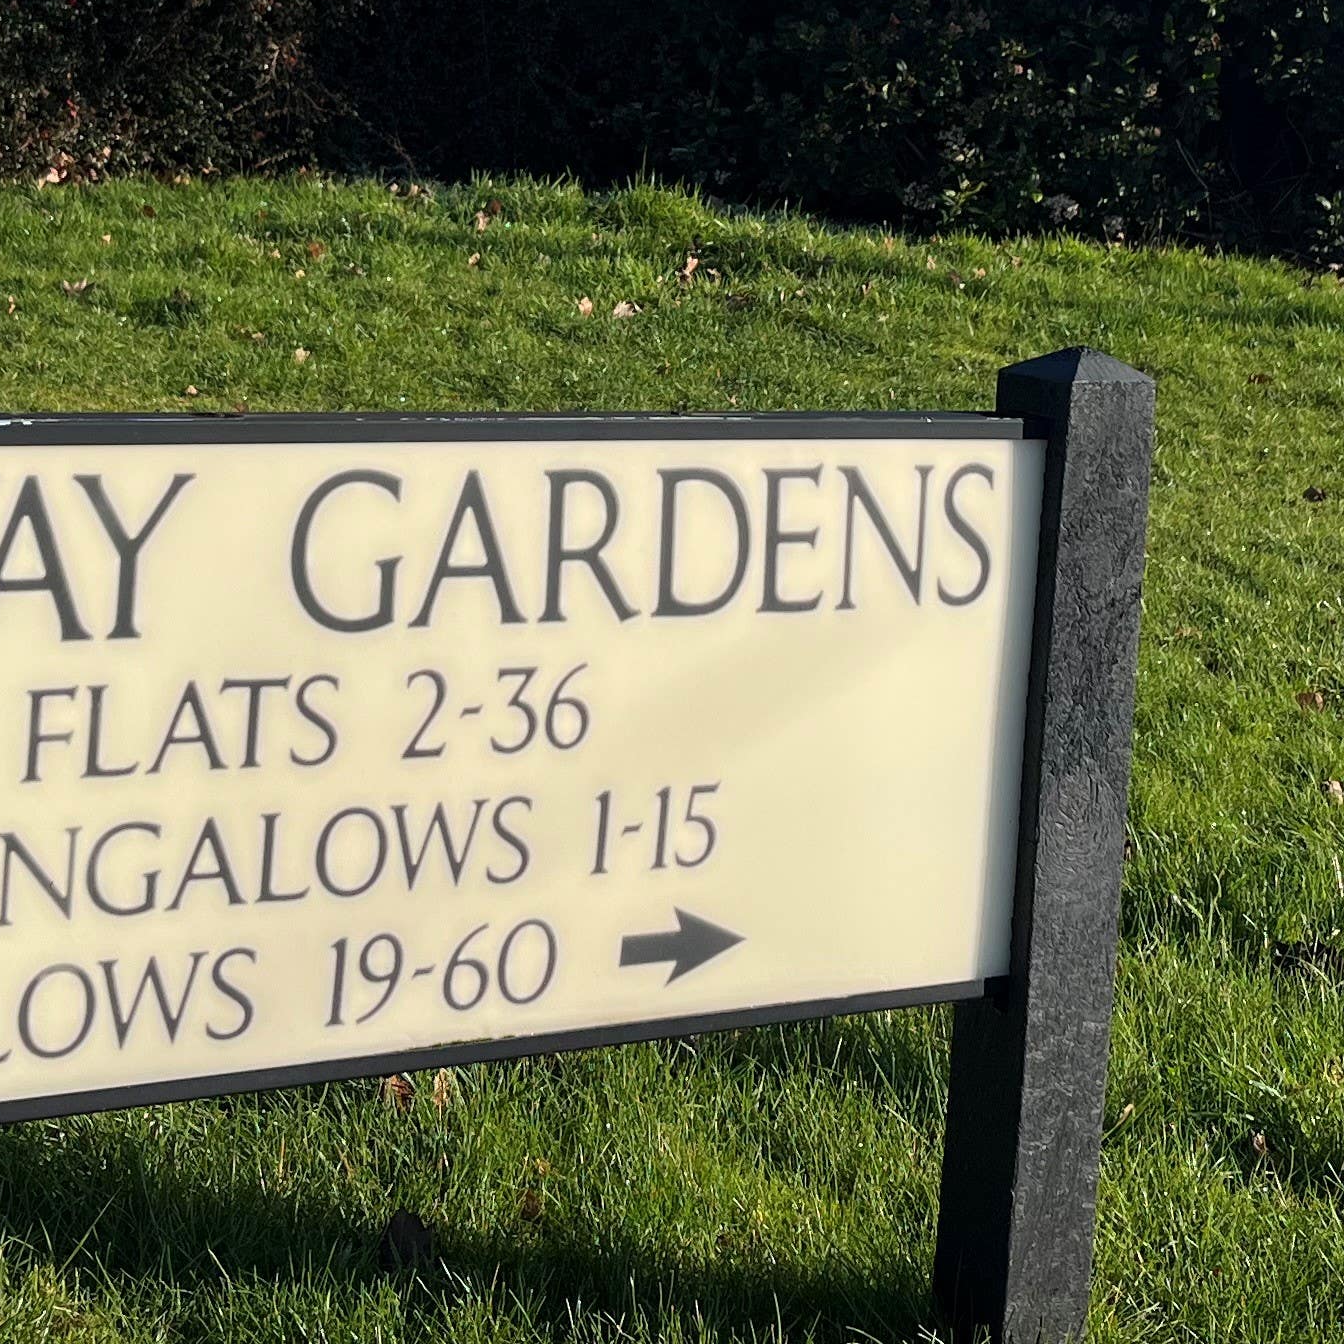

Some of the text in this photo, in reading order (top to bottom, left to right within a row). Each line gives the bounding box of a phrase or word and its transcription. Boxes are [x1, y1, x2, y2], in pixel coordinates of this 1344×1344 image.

[290, 462, 997, 634] GARDENS
[20, 663, 592, 784] FLATS 2-36
[589, 780, 722, 876] 1-15
[324, 917, 558, 1028] 19-60
